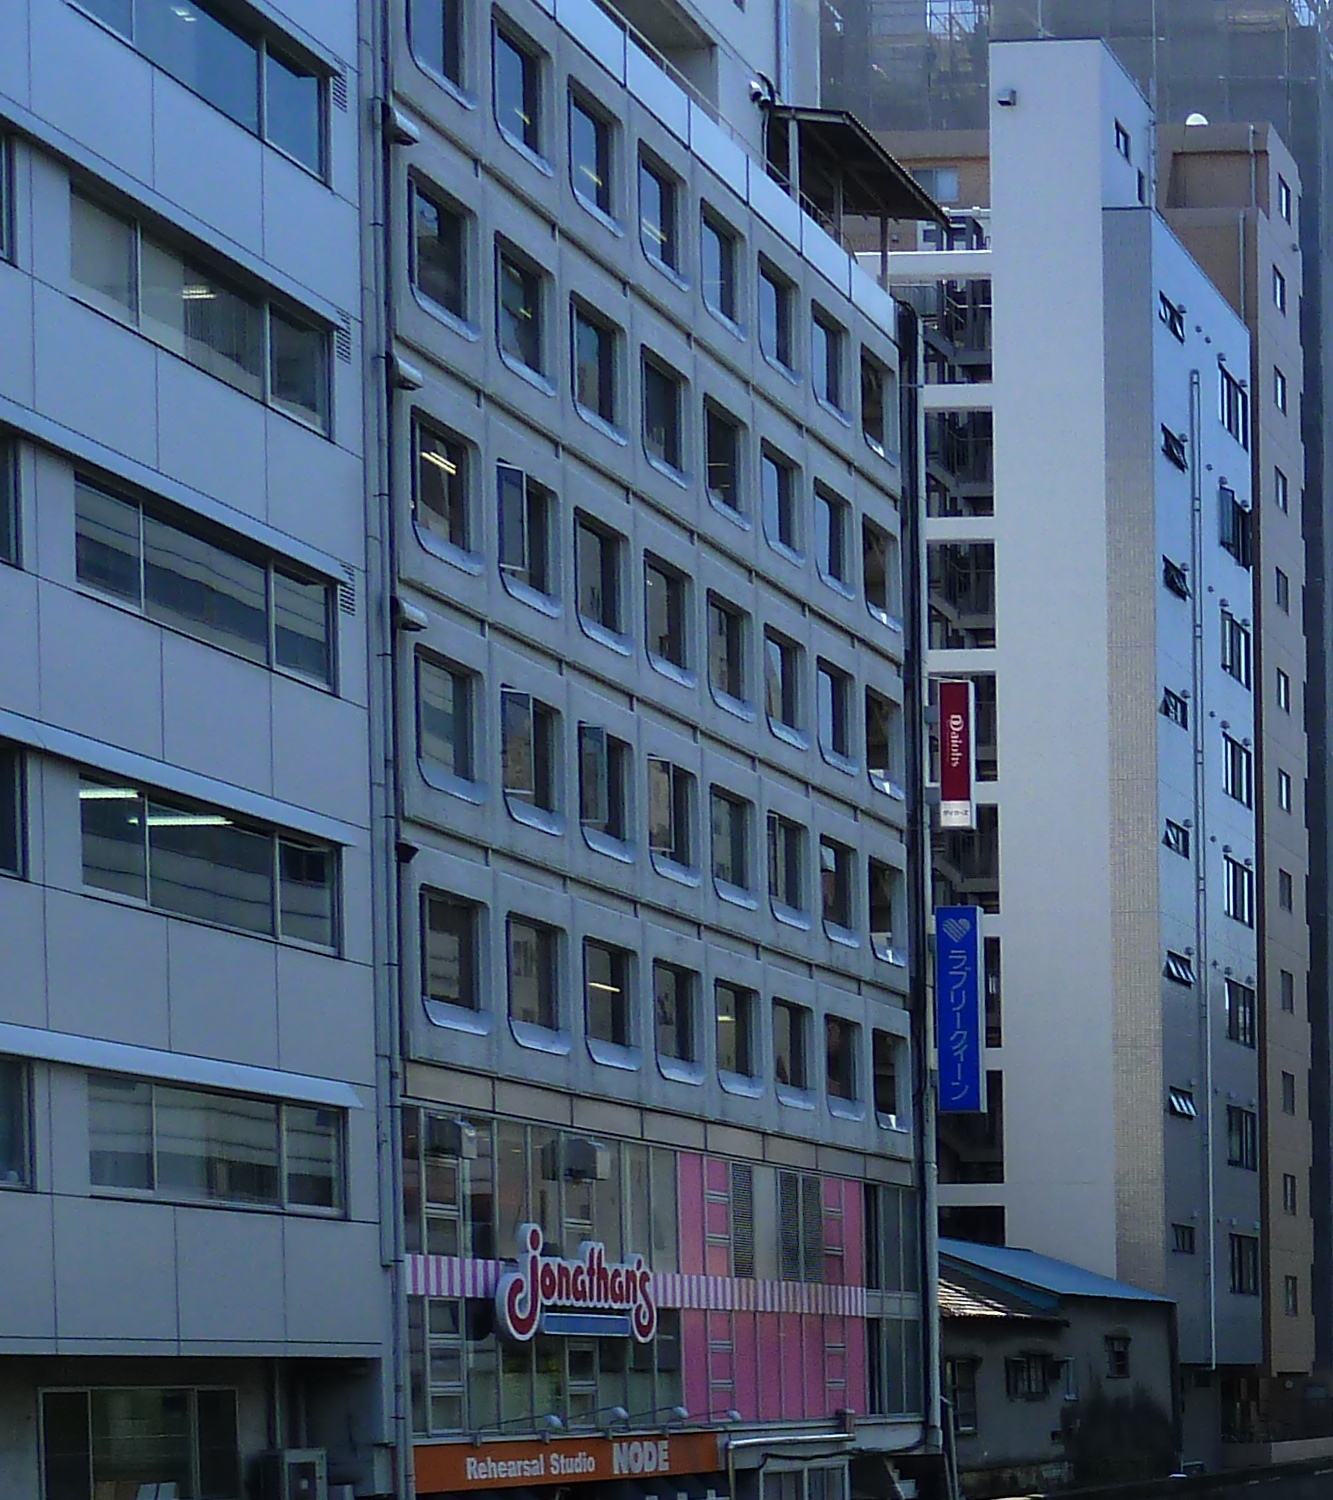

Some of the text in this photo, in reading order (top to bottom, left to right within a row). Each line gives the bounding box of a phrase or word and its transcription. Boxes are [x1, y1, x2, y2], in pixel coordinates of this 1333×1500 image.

[950, 714, 964, 768] Daiohs
[465, 1439, 670, 1480] Rehearsal Studio NODE
